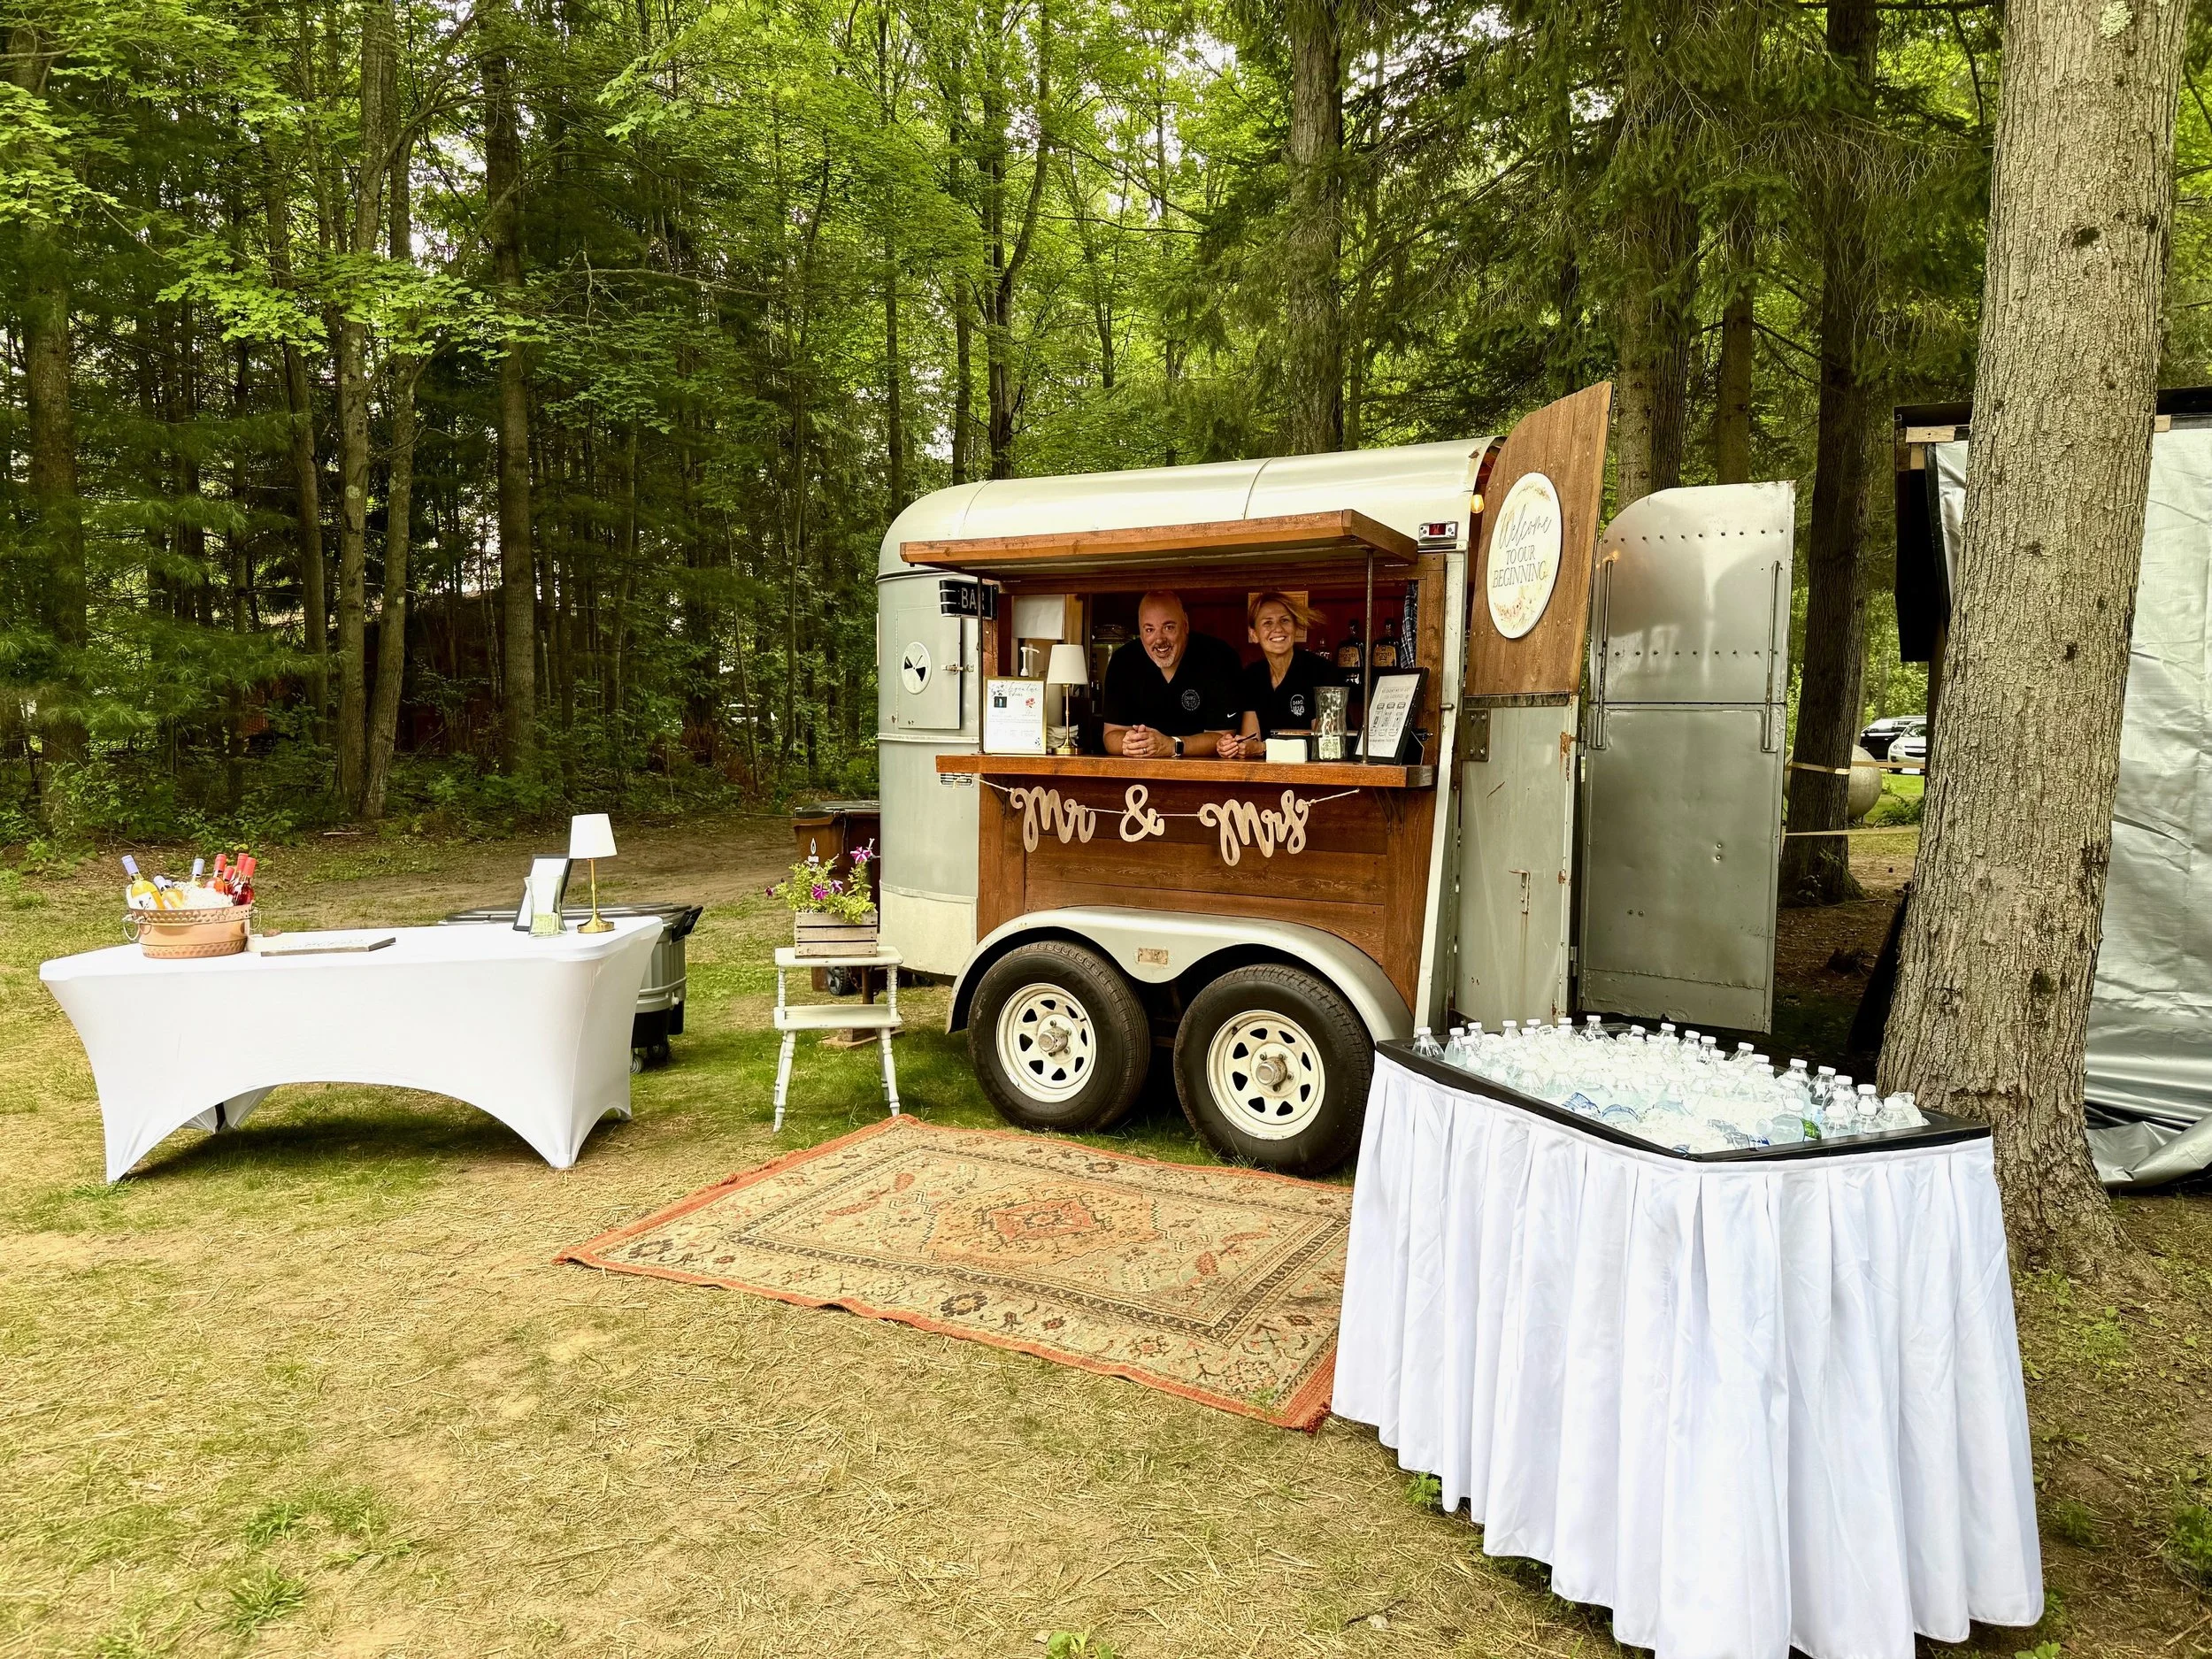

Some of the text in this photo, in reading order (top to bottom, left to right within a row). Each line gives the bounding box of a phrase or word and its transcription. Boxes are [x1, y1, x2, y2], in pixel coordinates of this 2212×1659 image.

[1499, 503, 1552, 549] Welcome
[1506, 544, 1536, 565] TO OUR
[1493, 560, 1548, 588] BEGINNING
[1010, 784, 1310, 867] Mr & Mrs
